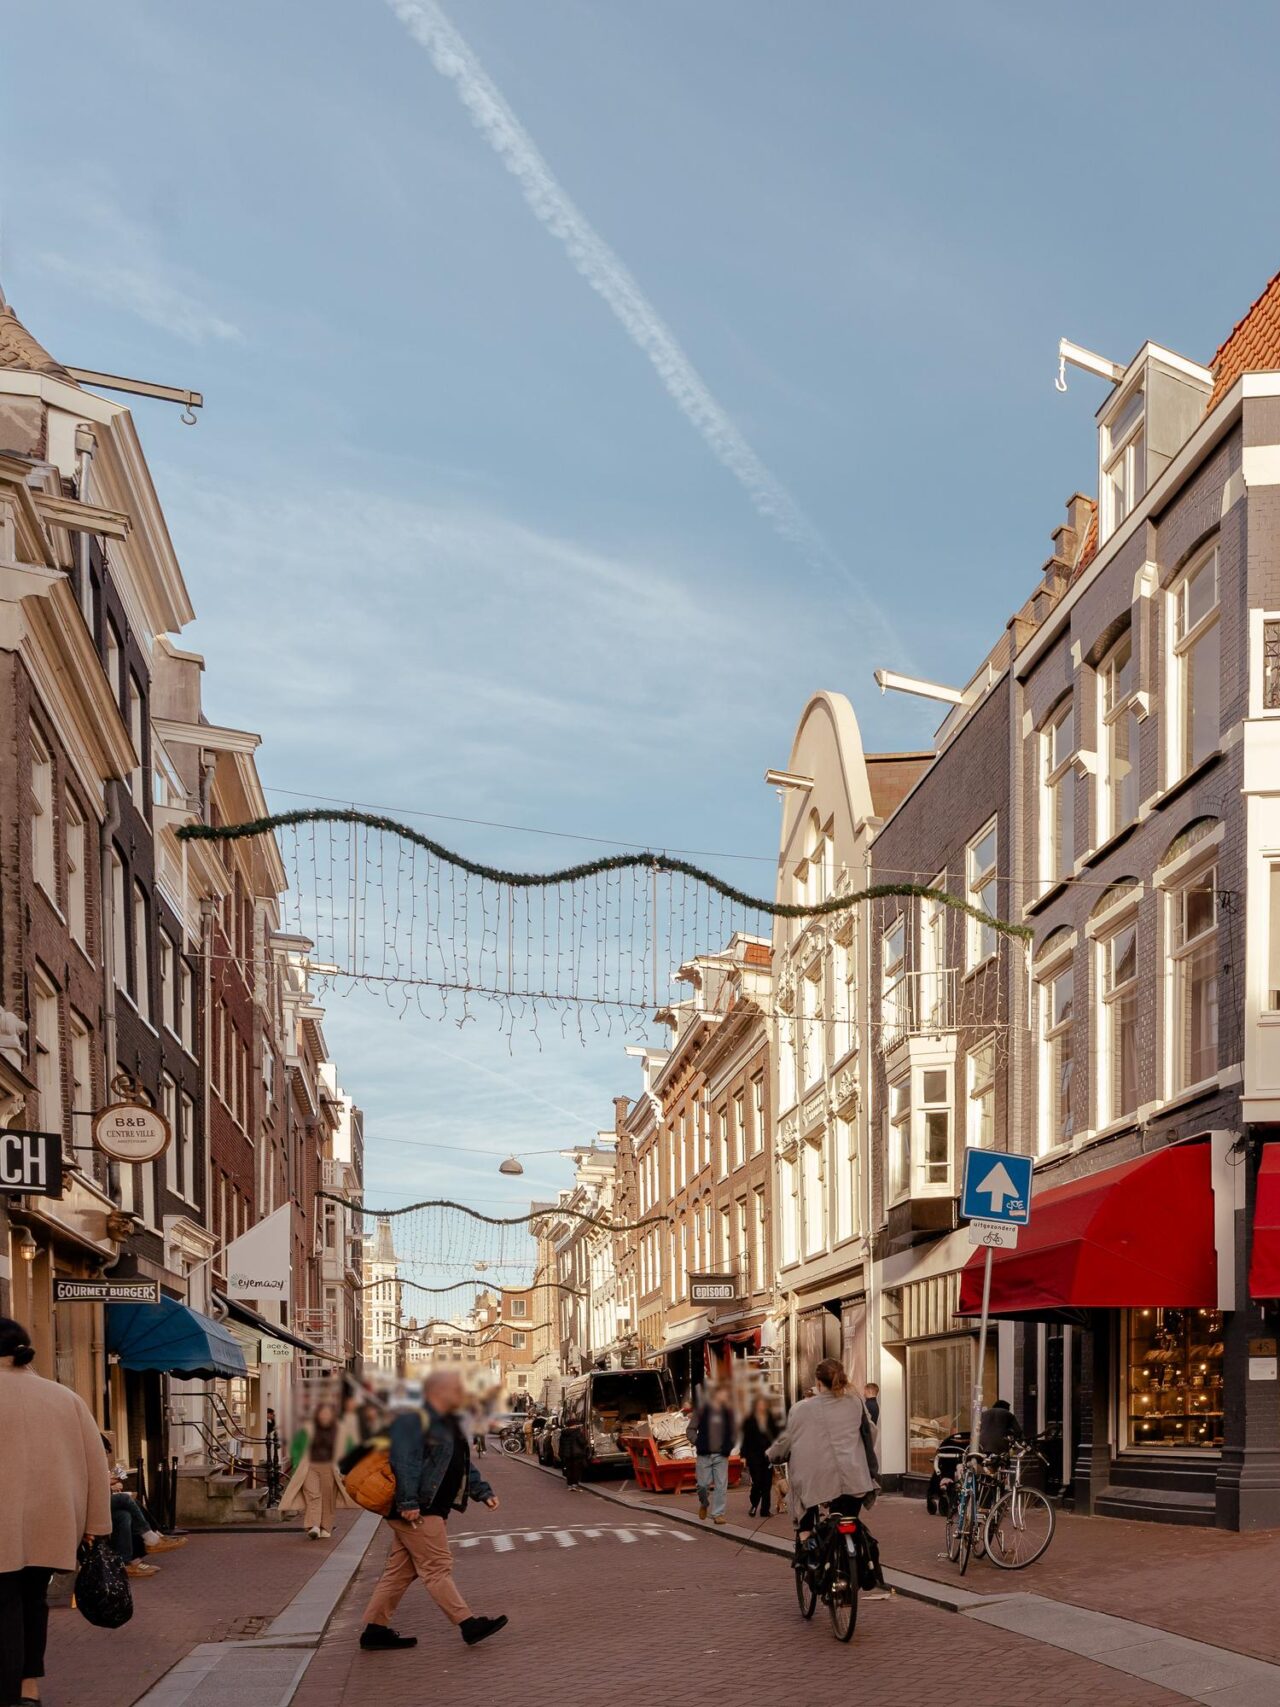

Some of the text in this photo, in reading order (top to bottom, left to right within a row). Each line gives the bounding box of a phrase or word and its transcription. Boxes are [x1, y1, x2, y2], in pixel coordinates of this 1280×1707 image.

[115, 1117, 146, 1127] B&B
[106, 1129, 155, 1138] CENTRE VILLE
[973, 1222, 1016, 1232] uitgezonderd
[238, 1279, 284, 1291] eyemazy
[57, 1284, 155, 1299] GOURMET BURGERS
[695, 1286, 730, 1298] episode
